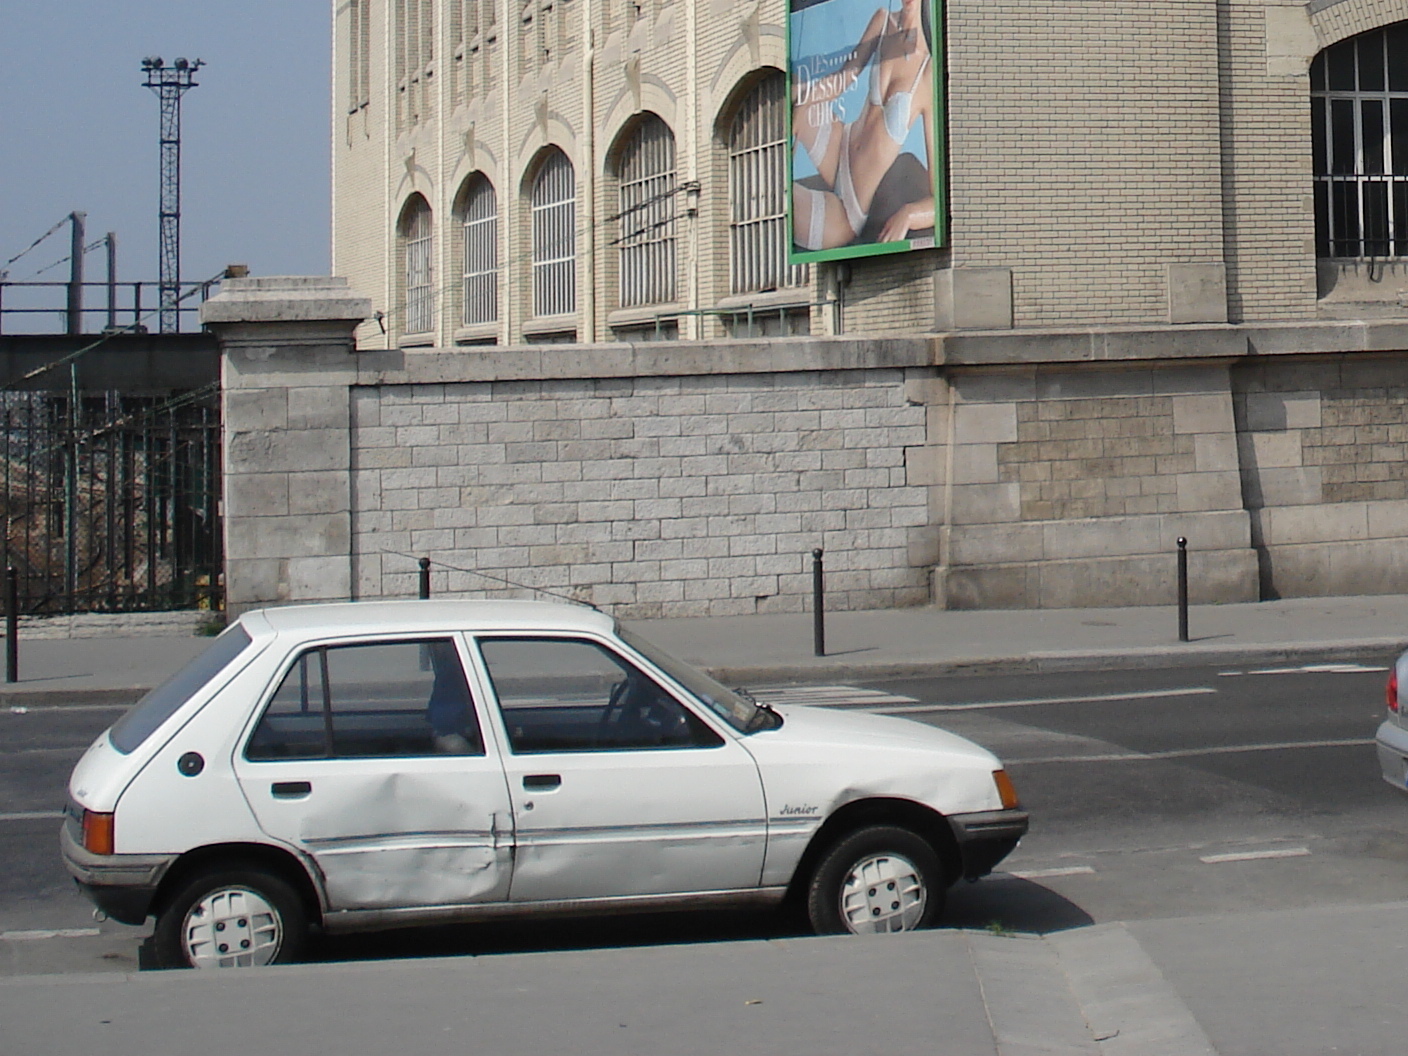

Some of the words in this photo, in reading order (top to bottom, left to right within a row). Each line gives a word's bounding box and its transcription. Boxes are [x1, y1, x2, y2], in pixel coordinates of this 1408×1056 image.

[811, 55, 829, 74] LES
[796, 64, 858, 106] DESSOUS
[808, 97, 846, 128] CHICS
[780, 803, 819, 815] Junior
